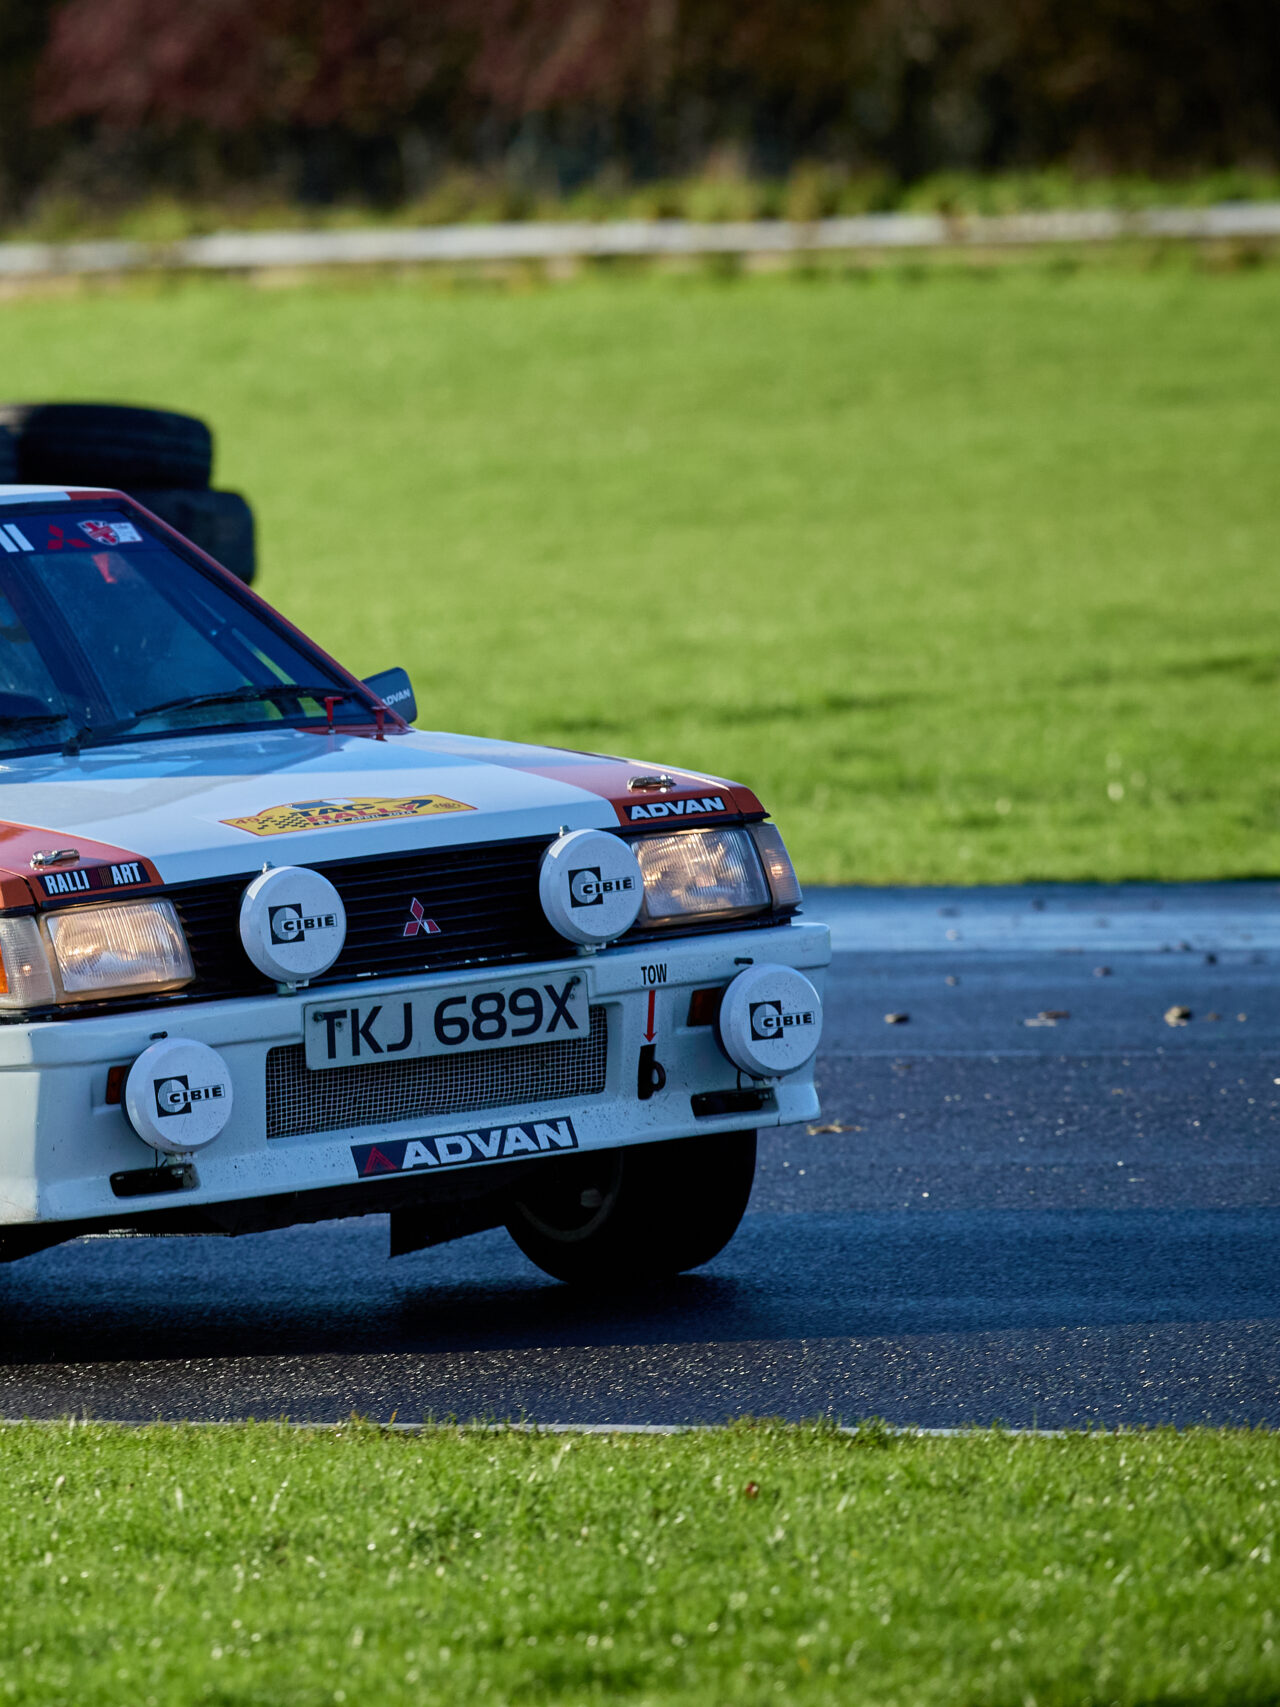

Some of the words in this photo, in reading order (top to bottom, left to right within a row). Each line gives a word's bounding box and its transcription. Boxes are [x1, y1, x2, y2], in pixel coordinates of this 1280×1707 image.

[297, 803, 376, 818] TAC
[305, 803, 418, 823] RALLY
[631, 796, 726, 820] ADVAN
[44, 869, 91, 895] RALLI
[111, 862, 142, 886] ART
[640, 963, 668, 986] TOW
[322, 1002, 413, 1060] TKJ
[433, 981, 579, 1046] 689X
[401, 1120, 574, 1170] ADVAN
